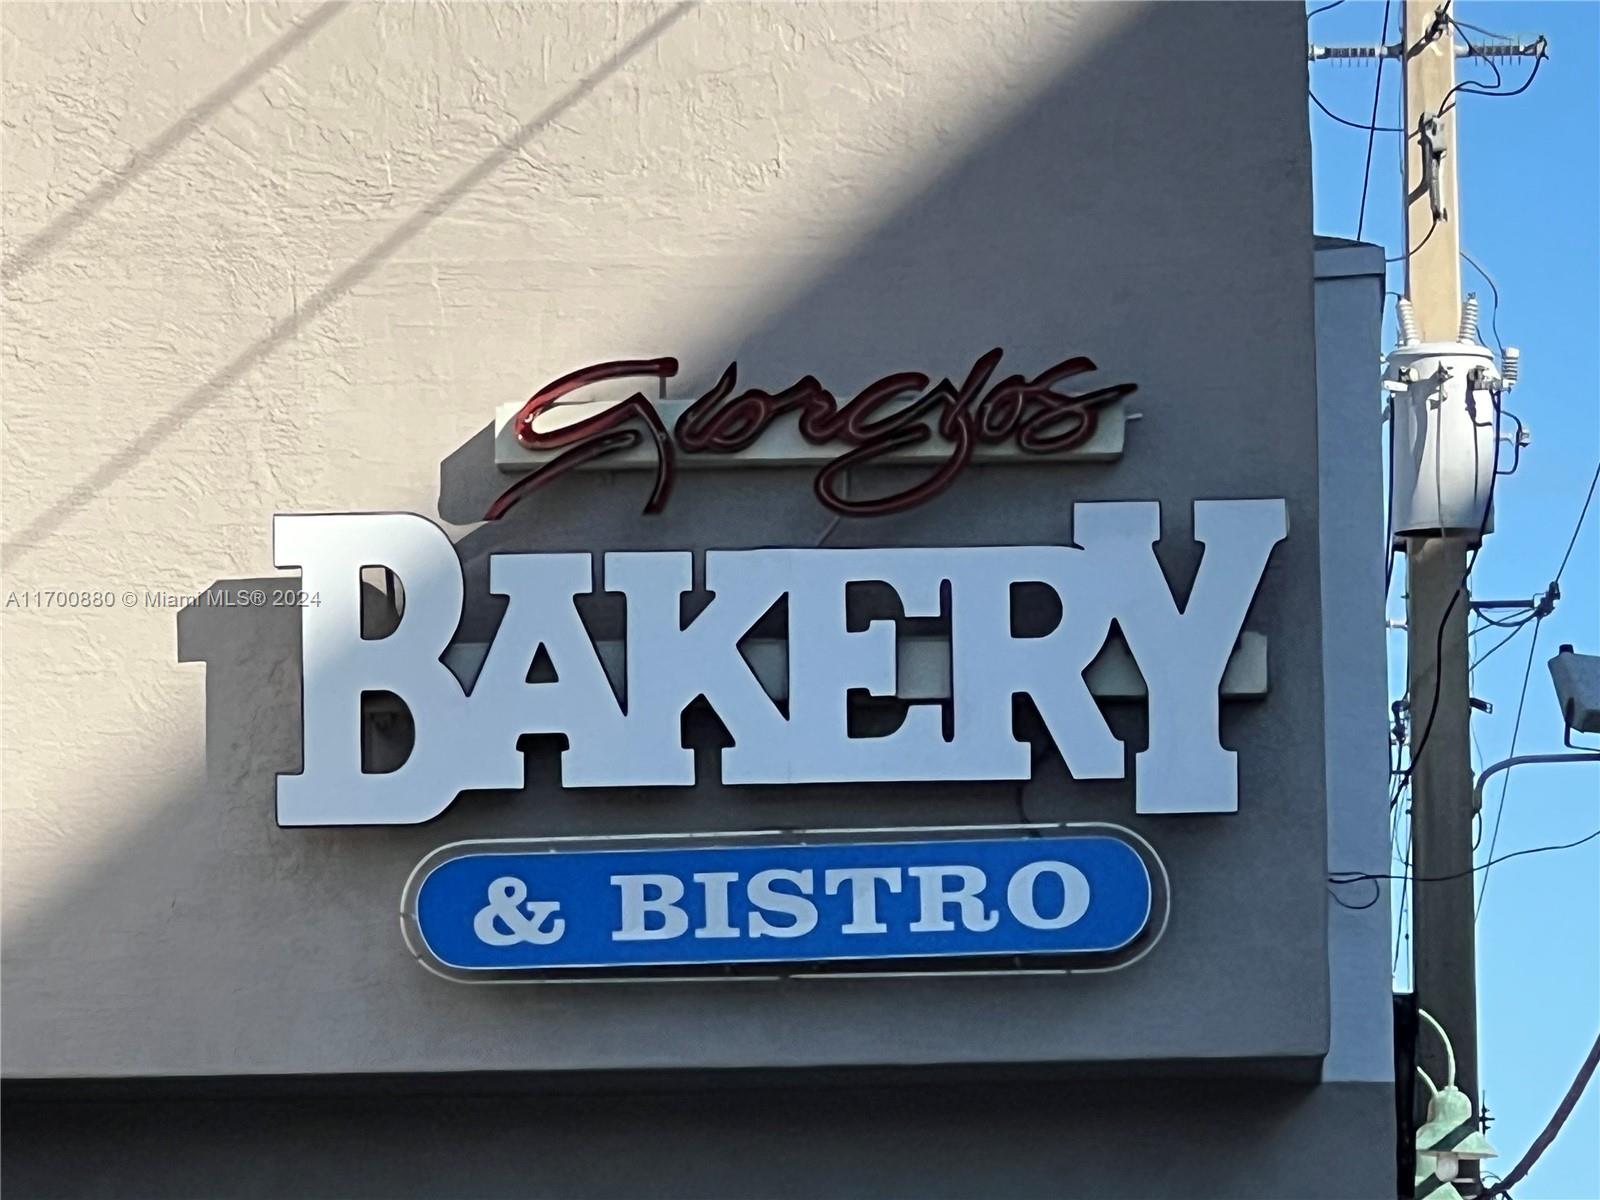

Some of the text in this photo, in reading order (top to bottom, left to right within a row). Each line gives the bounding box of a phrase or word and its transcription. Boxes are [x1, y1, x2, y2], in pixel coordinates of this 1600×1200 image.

[273, 498, 1288, 827] BAKERY
[473, 860, 1092, 947] & BISTRO
